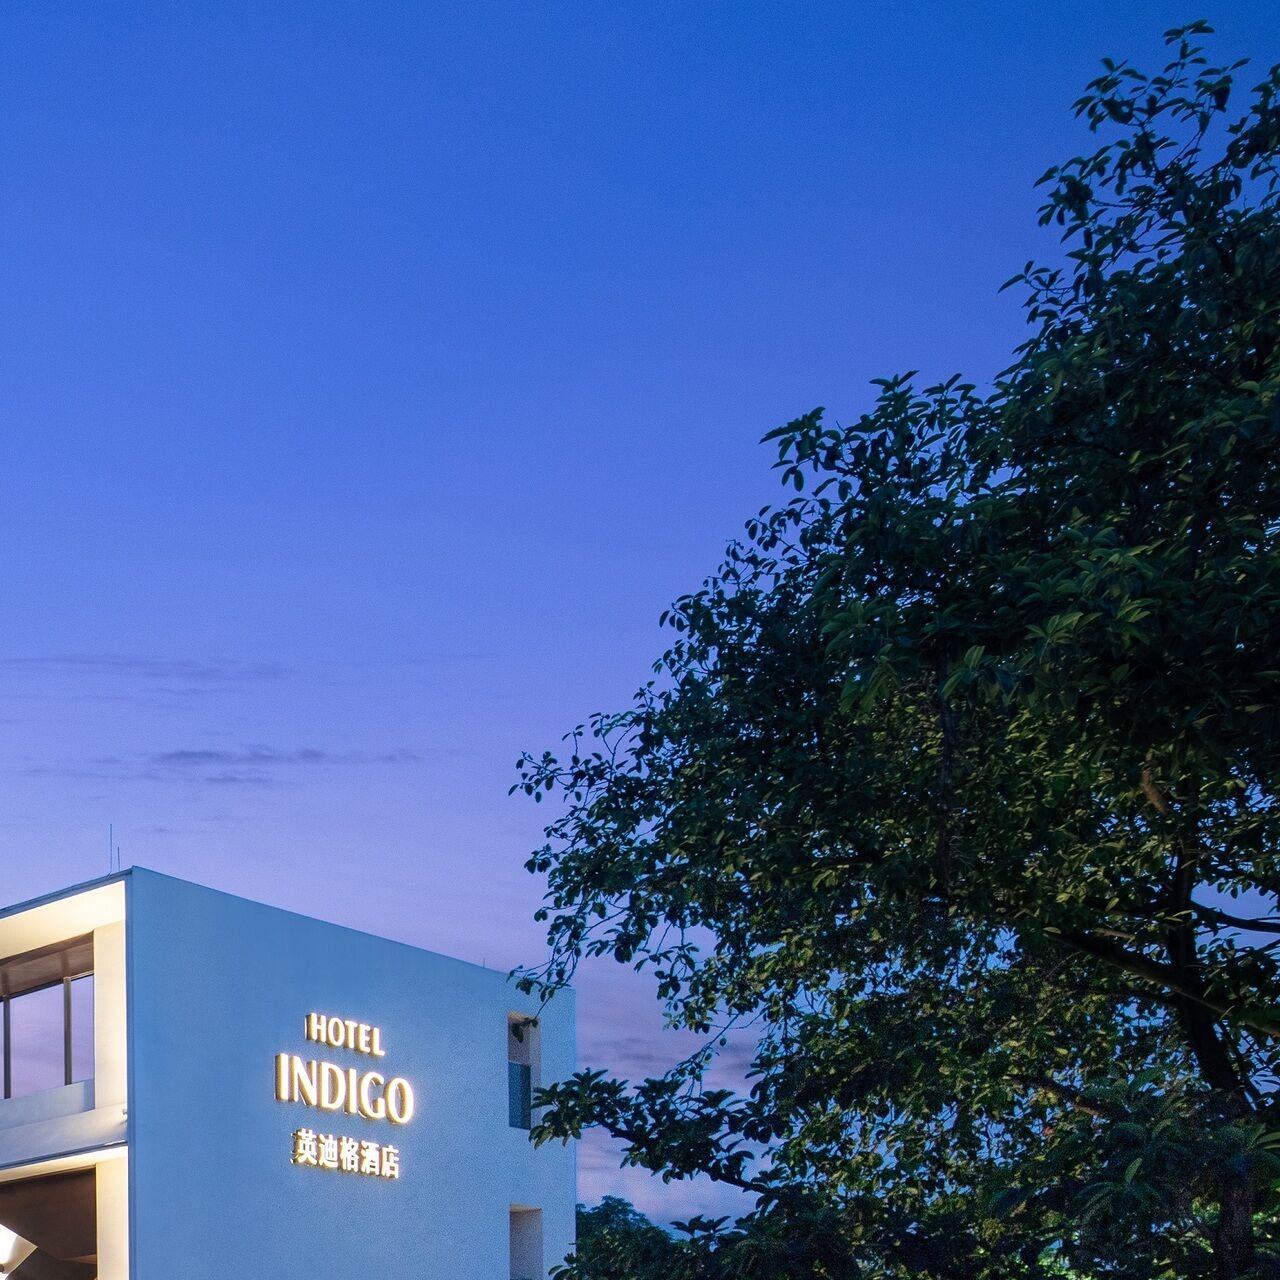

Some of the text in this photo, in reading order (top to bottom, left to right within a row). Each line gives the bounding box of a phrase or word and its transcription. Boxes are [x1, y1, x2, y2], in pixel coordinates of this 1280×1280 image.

[305, 1012, 385, 1057] HOTEL
[274, 1053, 415, 1124] INDIGO
[291, 1128, 400, 1179] 英迪格酒店
